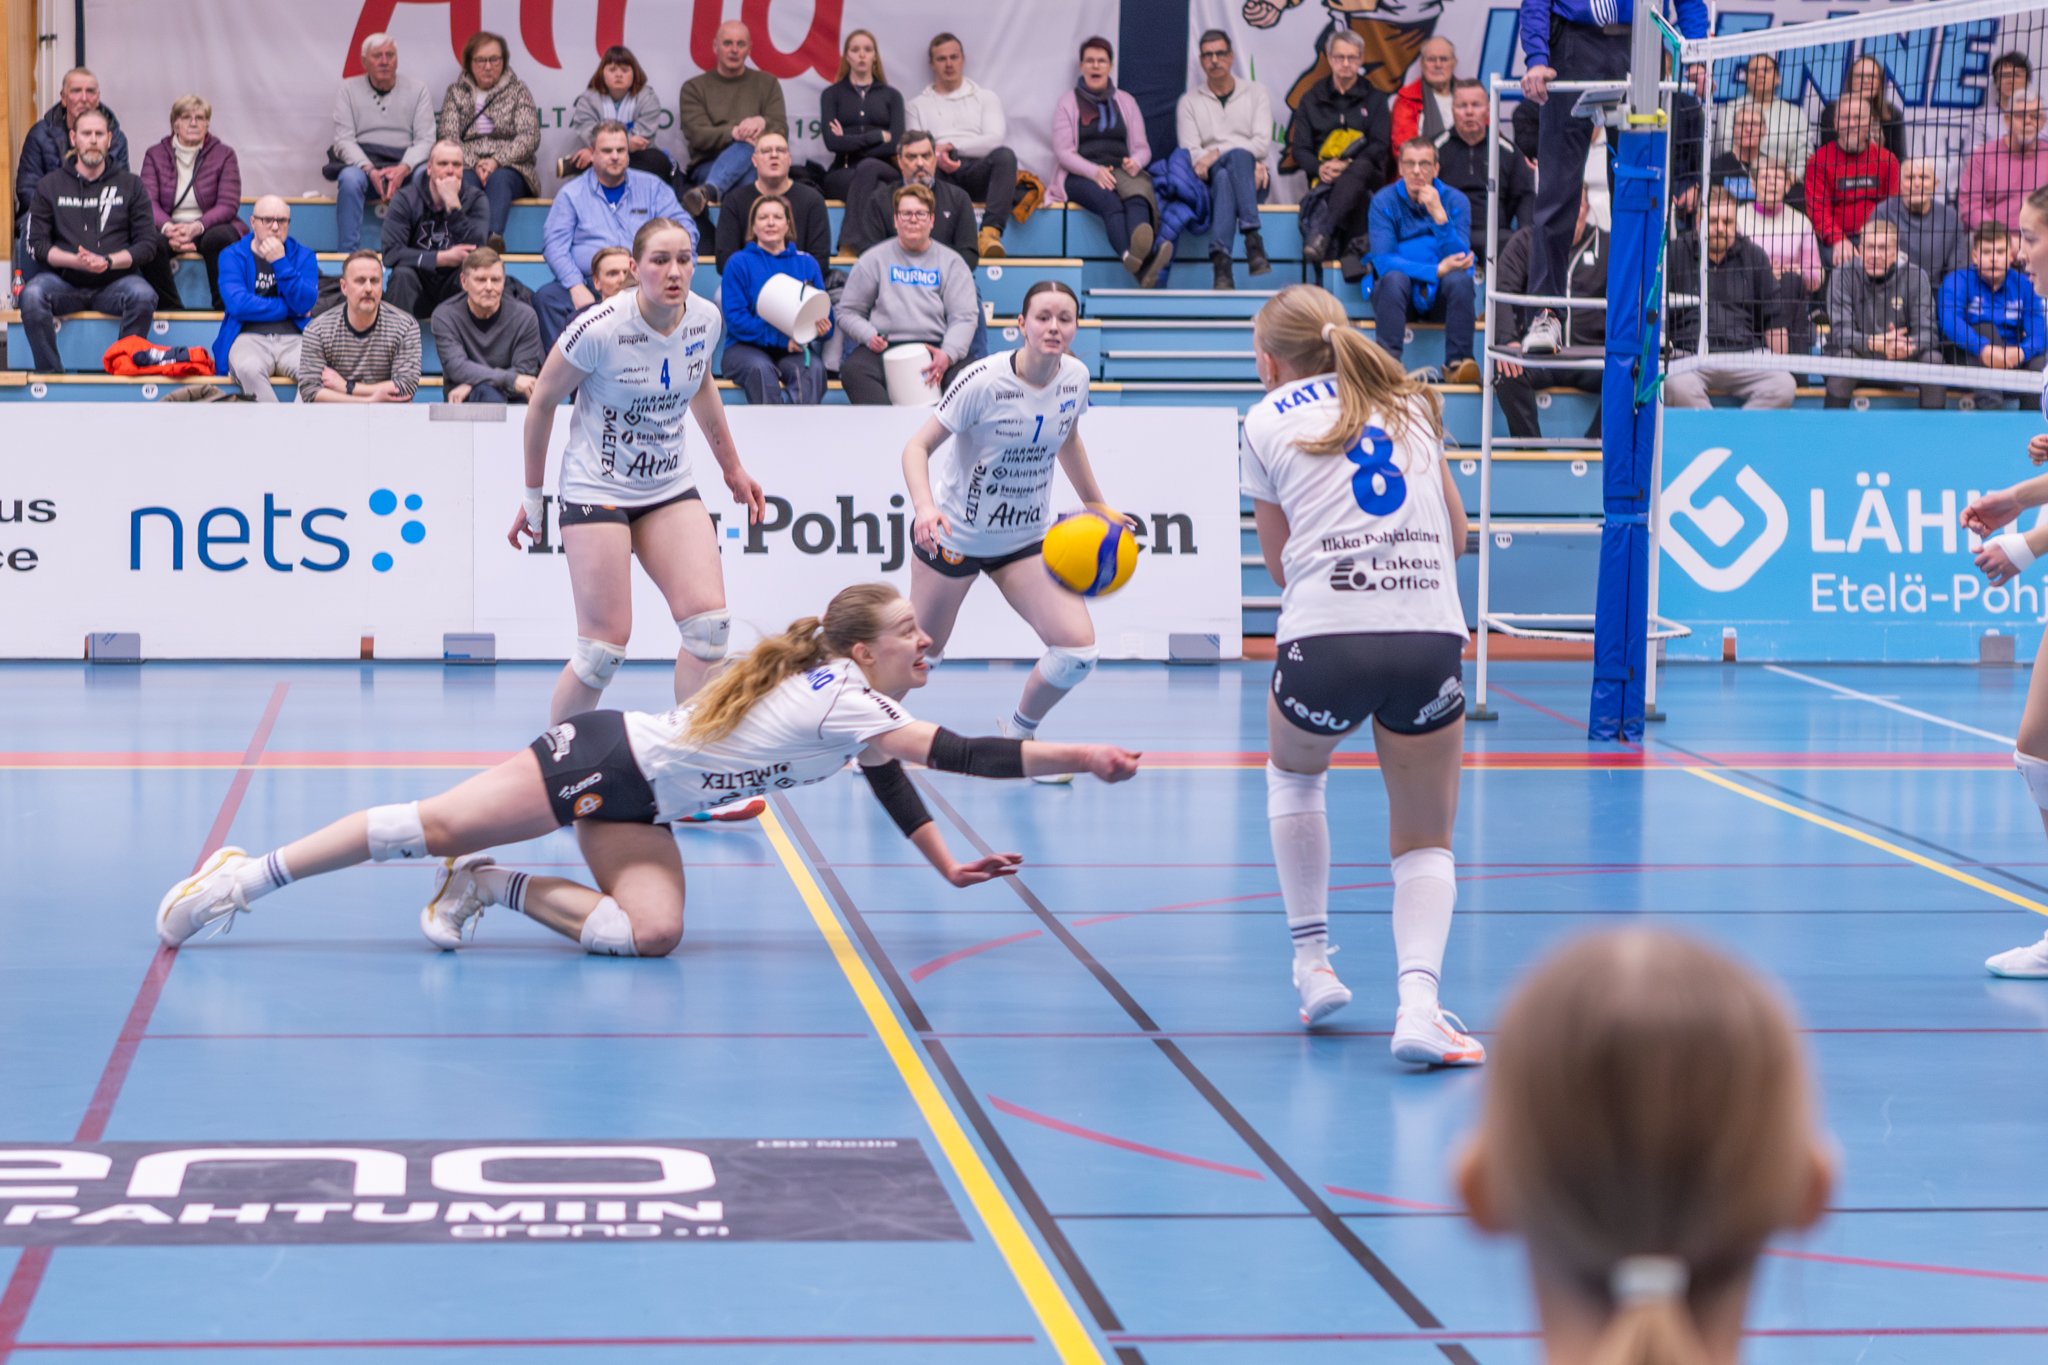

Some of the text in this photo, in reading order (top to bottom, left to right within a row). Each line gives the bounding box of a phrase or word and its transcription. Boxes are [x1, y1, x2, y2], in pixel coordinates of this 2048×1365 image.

[893, 267, 938, 285] NURMO
[660, 357, 671, 391] 4
[1032, 414, 1044, 444] 7
[602, 419, 617, 480] MELTEX
[626, 450, 678, 479] Atria
[1344, 425, 1407, 517] 8
[963, 473, 982, 528] MELTEX
[987, 501, 1041, 528] Atria
[130, 492, 351, 573] nets
[1372, 555, 1441, 572] Lakeus
[1380, 576, 1440, 591] Office
[1283, 696, 1351, 731] sedu
